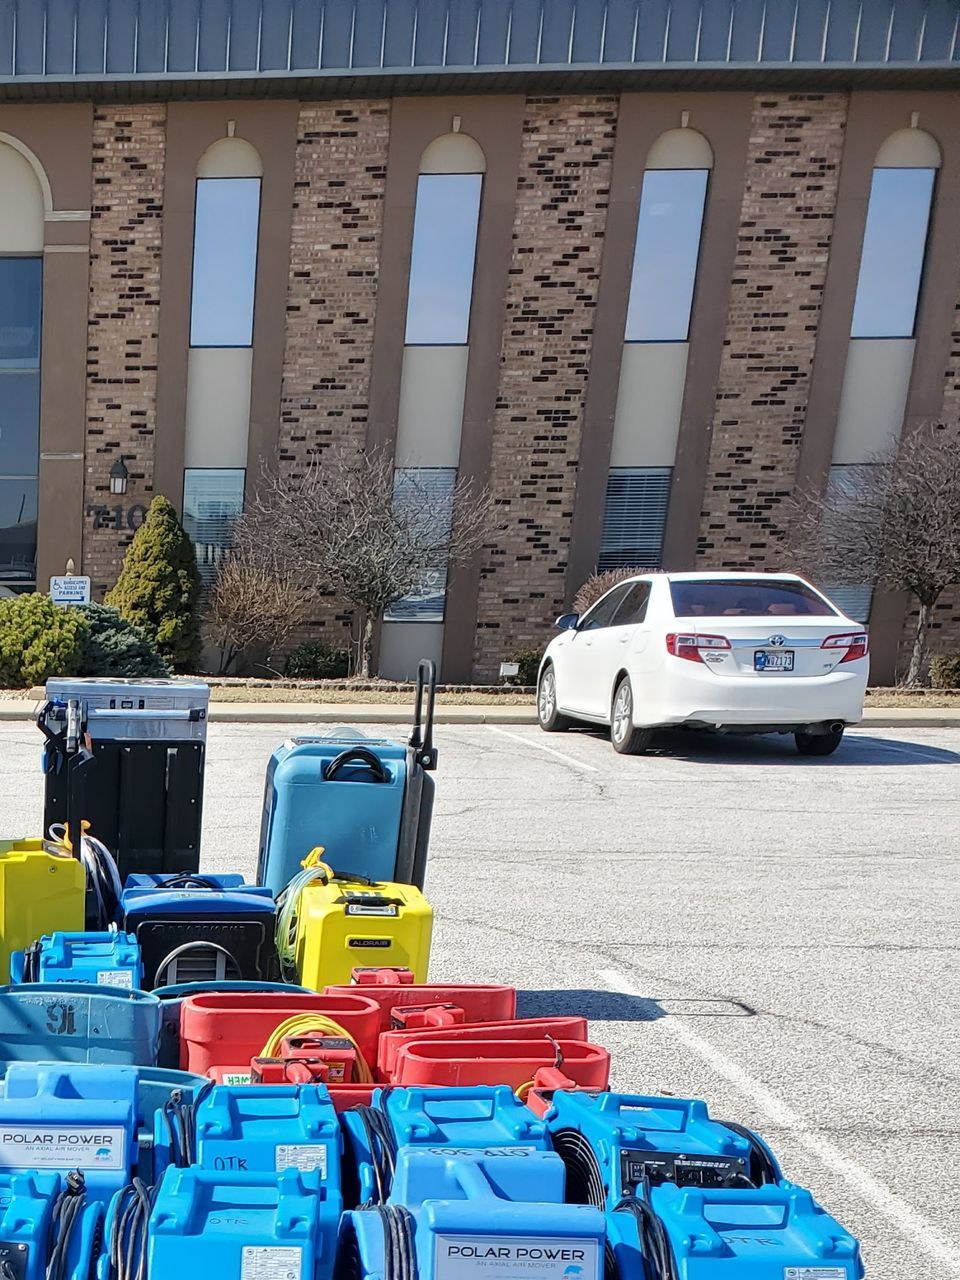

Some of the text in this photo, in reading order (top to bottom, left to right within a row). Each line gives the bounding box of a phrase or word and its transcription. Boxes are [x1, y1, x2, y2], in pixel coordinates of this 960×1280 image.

[87, 505, 147, 530] 710
[3, 1134, 113, 1145] POLAR POWER
[448, 1246, 585, 1261] POLAR POWER
